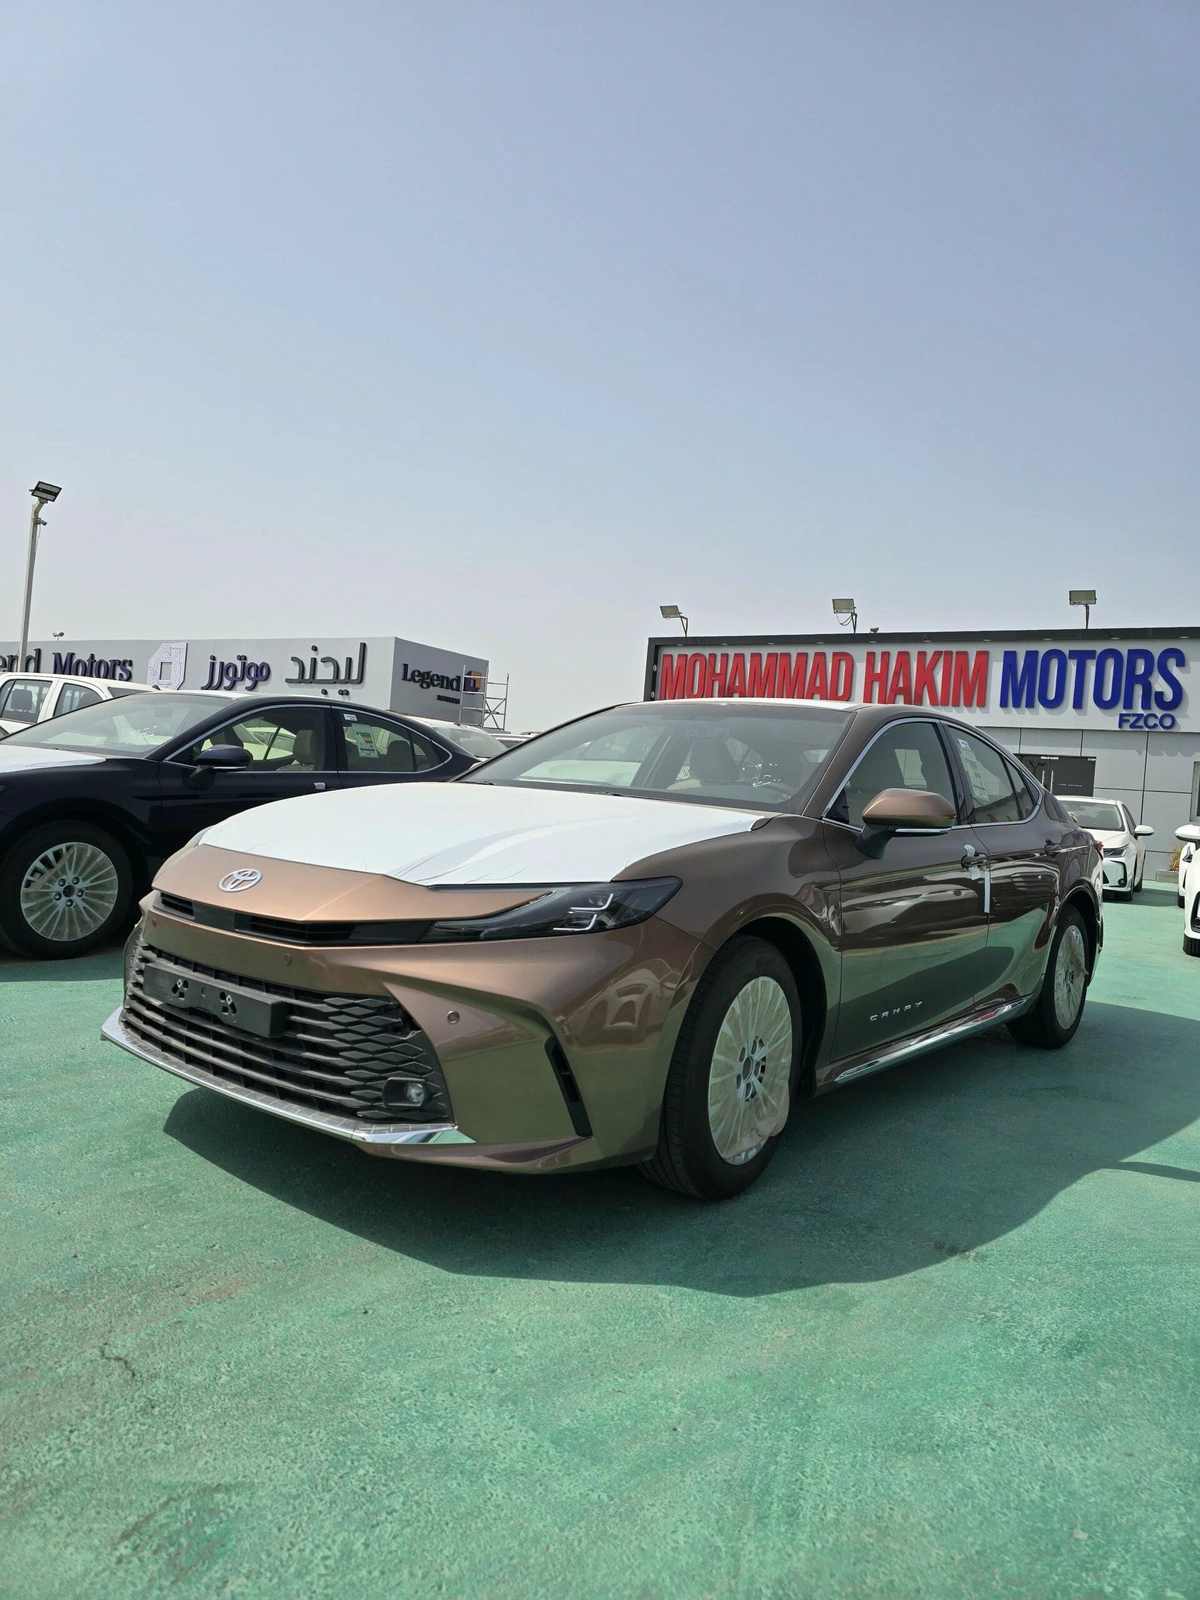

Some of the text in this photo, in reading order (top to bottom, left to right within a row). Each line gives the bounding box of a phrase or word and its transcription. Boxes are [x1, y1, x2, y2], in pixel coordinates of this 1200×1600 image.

[52, 652, 133, 681] Motors
[200, 642, 367, 696] ليجند موتورز
[402, 663, 461, 692] Legend
[659, 648, 1186, 711] MOHAMMAD HAKIM MOTORS
[1118, 712, 1176, 730] FZCO
[869, 1001, 923, 1021] CAMRY
